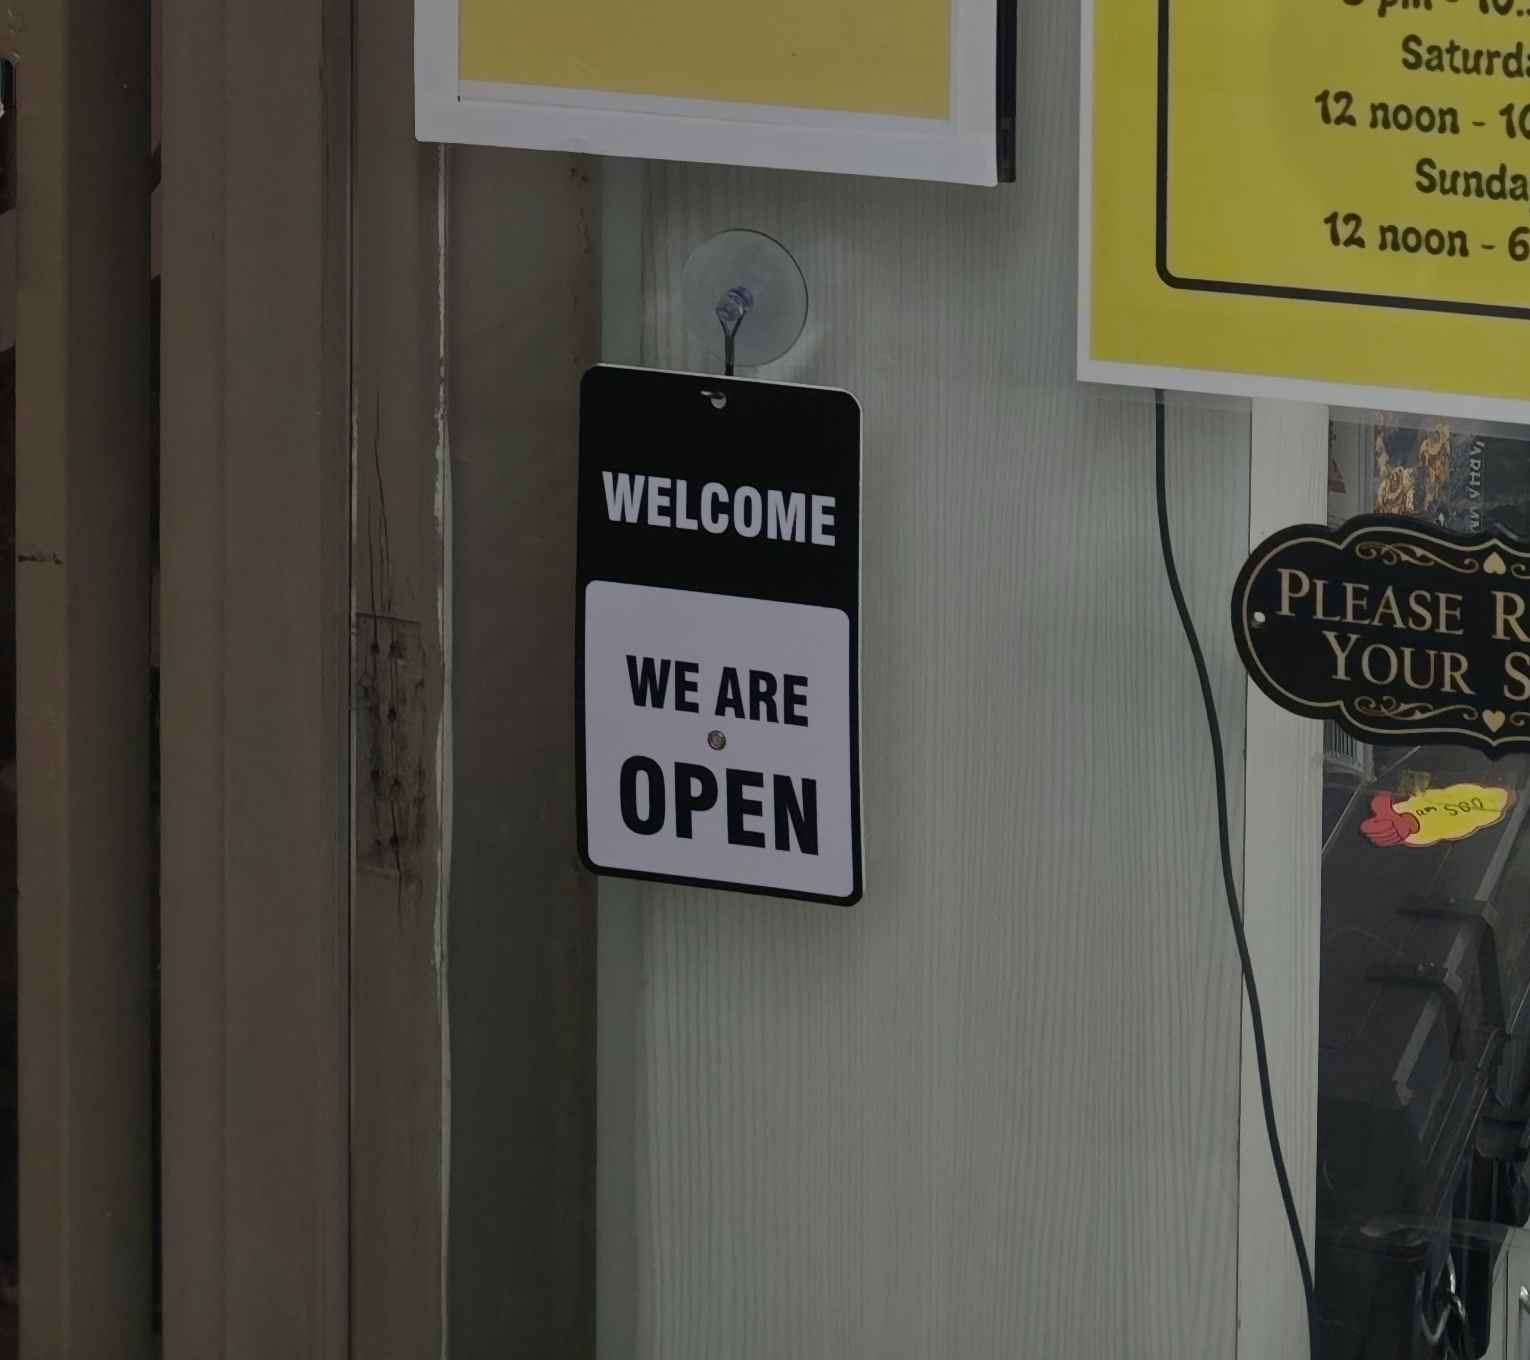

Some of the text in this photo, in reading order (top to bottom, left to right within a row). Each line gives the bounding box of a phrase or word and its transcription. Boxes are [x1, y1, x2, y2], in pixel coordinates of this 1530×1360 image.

[1315, 89, 1357, 127] 12
[1369, 98, 1460, 135] noon
[1324, 211, 1366, 249] 12
[1378, 221, 1469, 258] noon
[602, 471, 836, 547] WELCOME
[1277, 567, 1465, 637] PLEASE
[625, 654, 809, 727] WE ARE
[1323, 630, 1475, 695] YOUR
[619, 755, 819, 856] OPEN
